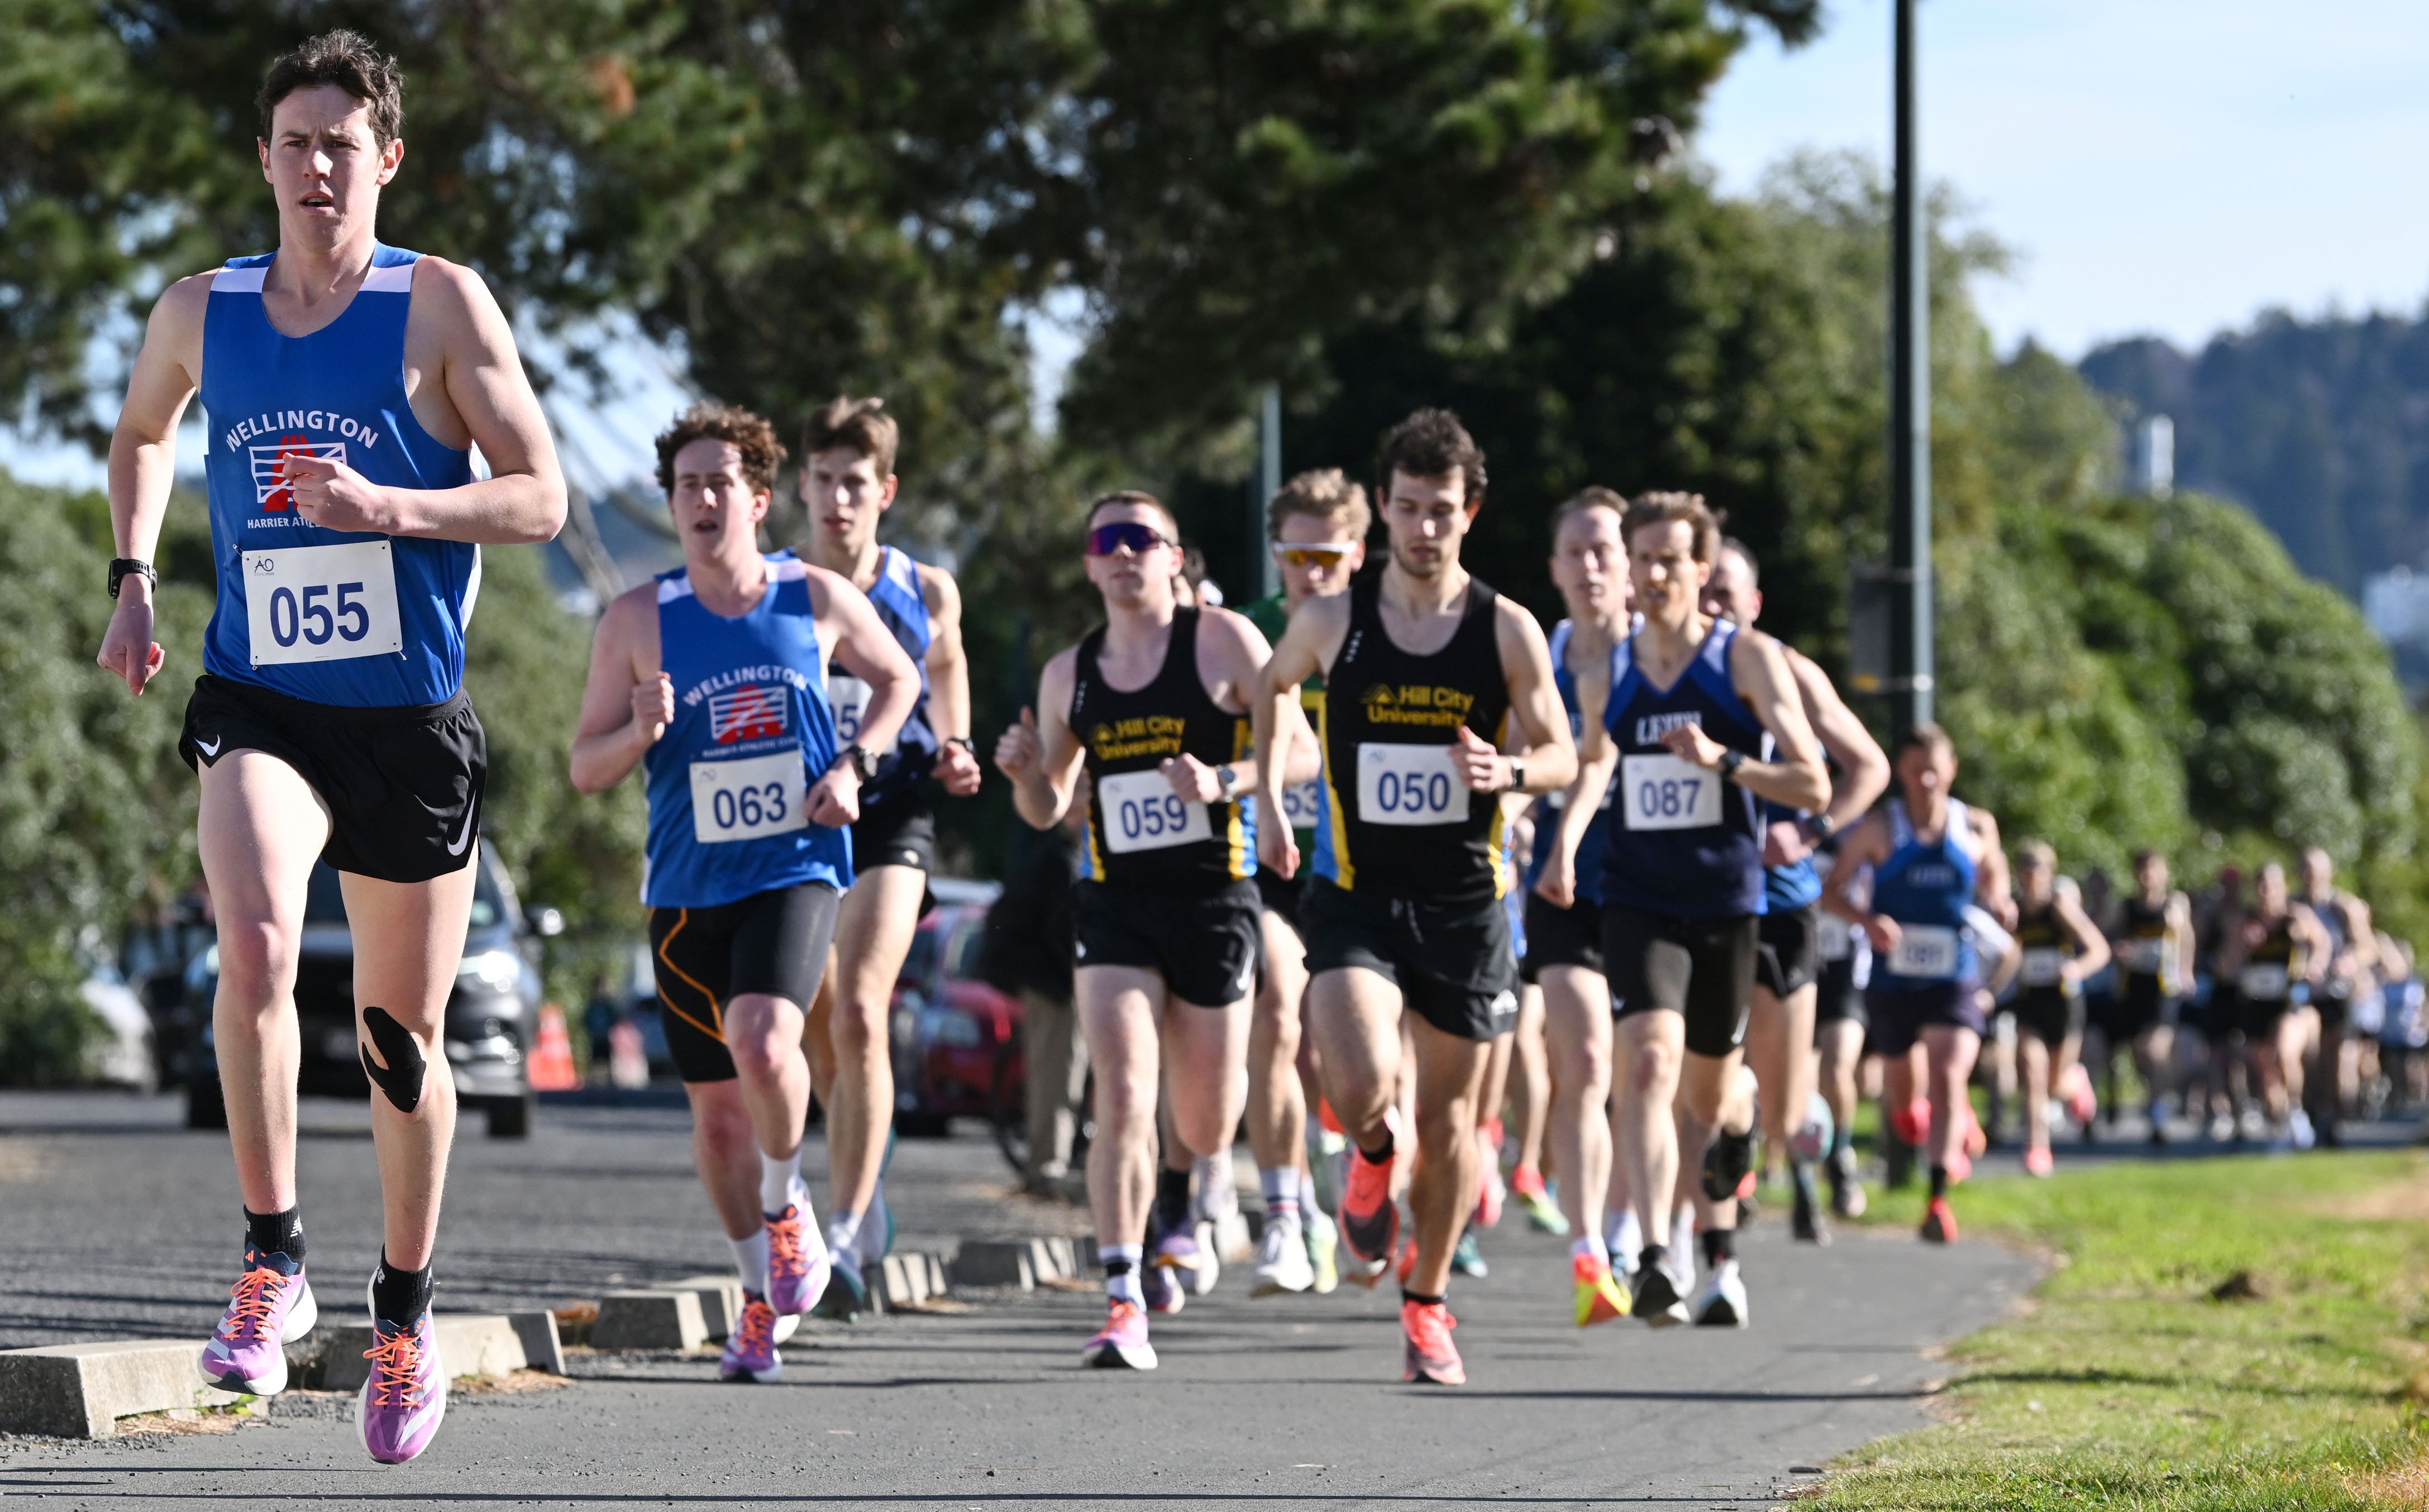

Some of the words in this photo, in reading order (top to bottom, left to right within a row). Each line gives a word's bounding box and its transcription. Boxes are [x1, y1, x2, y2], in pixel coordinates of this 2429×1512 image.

[226, 410, 379, 453] WELLINGTON
[247, 517, 289, 529] HARRIER
[270, 581, 370, 648] 055
[683, 665, 809, 706] WELLINGTON
[1399, 685, 1431, 706] Hill
[1433, 686, 1474, 713] City
[1115, 717, 1144, 739] Hill
[1146, 715, 1186, 736] City
[1367, 704, 1468, 729] University
[1094, 735, 1183, 762] University
[714, 782, 788, 829] 063
[1378, 771, 1450, 813] 050
[1640, 779, 1700, 816] 087
[1121, 794, 1188, 840] 059
